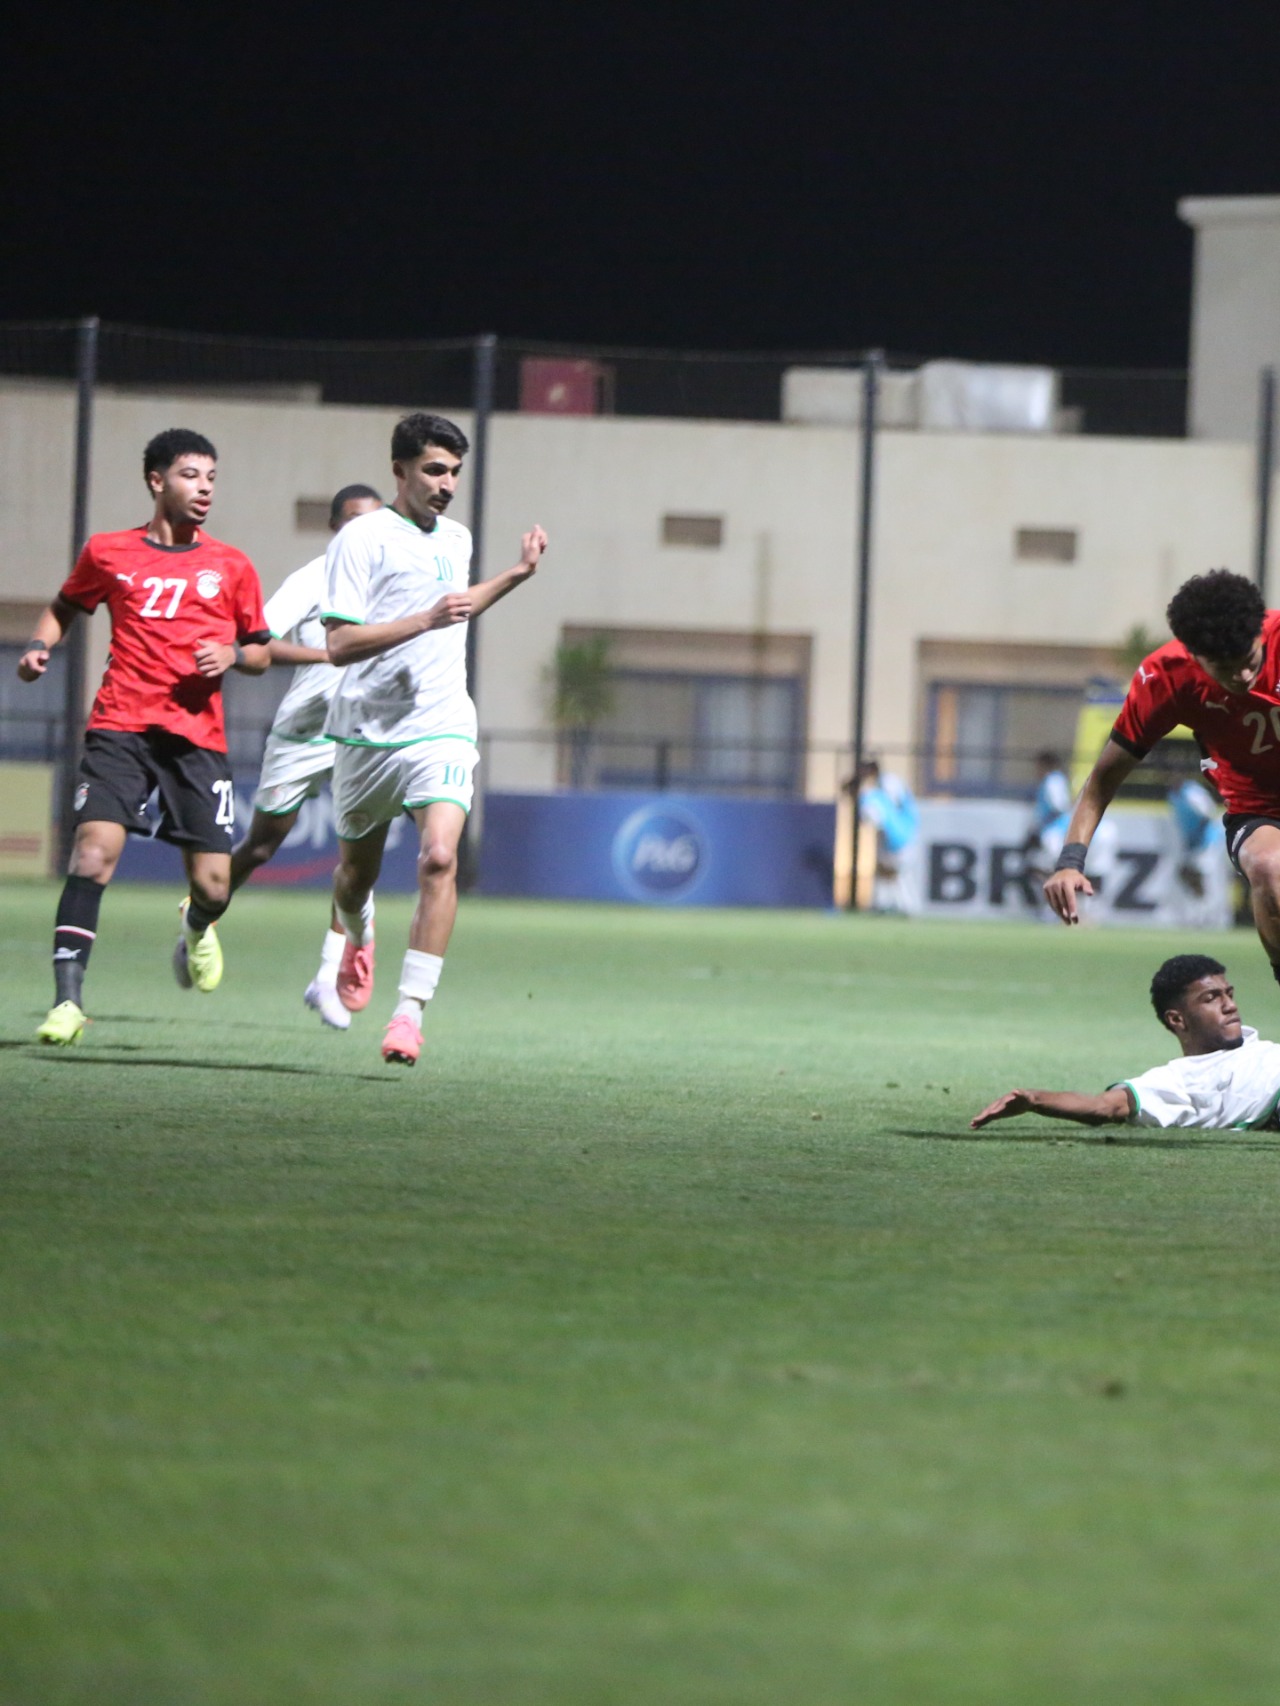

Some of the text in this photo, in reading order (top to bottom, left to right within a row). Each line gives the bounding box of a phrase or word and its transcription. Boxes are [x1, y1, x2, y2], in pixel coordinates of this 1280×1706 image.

[433, 554, 455, 583] 10
[140, 576, 188, 620] 27
[441, 764, 467, 788] 10
[928, 842, 1160, 910] BRZ
